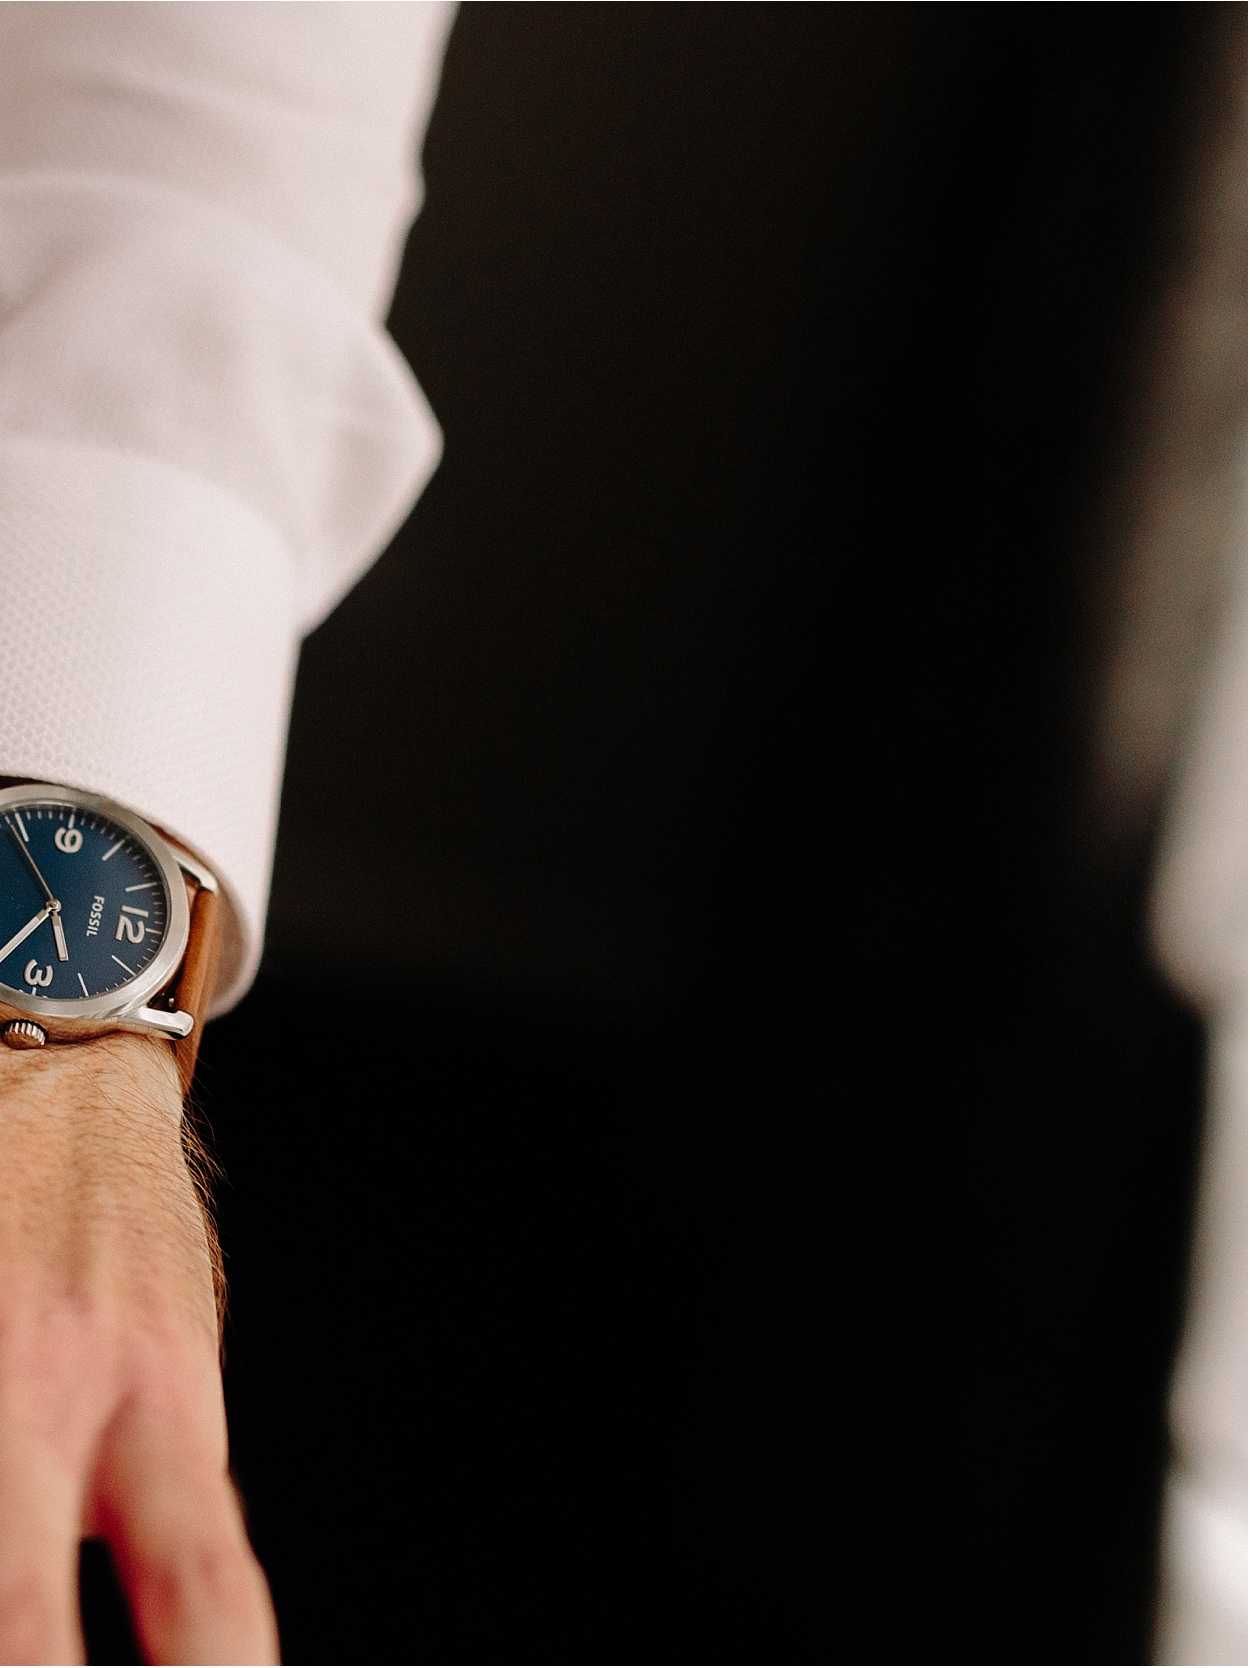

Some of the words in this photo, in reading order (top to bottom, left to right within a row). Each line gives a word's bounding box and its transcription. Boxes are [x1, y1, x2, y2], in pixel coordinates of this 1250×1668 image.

[54, 827, 84, 854] 9
[86, 895, 105, 937] FOSSIL
[115, 905, 149, 944] 12
[23, 958, 54, 988] 3
